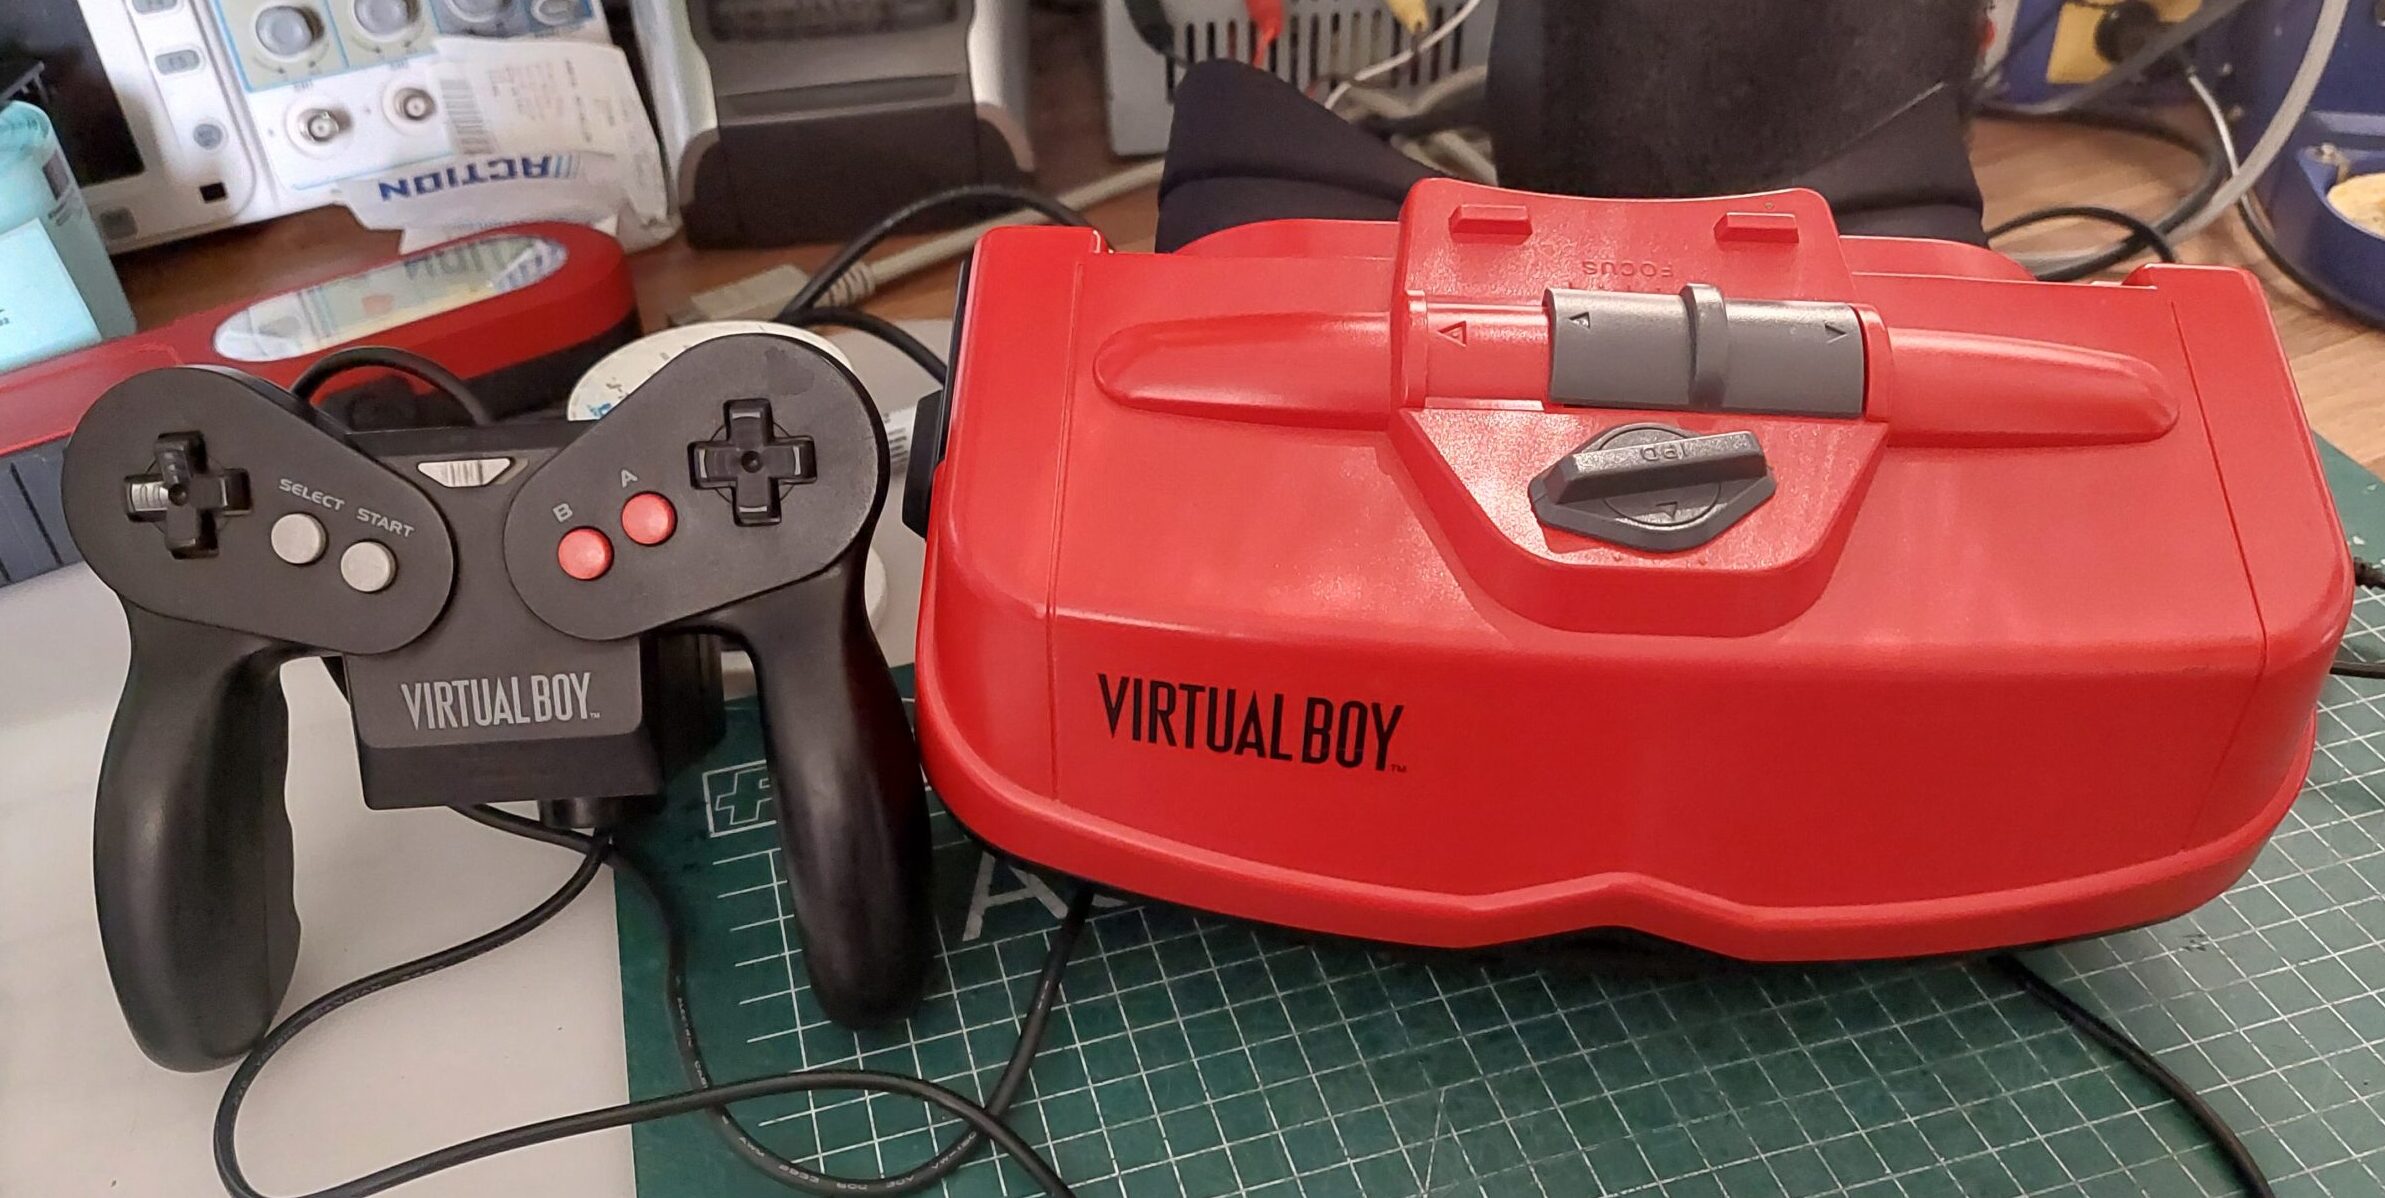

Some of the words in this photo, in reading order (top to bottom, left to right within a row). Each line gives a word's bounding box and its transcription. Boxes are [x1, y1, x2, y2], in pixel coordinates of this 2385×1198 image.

[378, 154, 552, 201] ACTION
[1581, 261, 1674, 278] FOCUS
[1639, 441, 1688, 462] IPD
[278, 477, 346, 512] SELECT
[620, 468, 639, 489] A
[355, 506, 416, 539] START
[551, 502, 574, 524] B
[400, 675, 531, 731] VIRTUAL
[529, 671, 592, 723] BOY
[1096, 671, 1292, 761] VIRTUAL
[1300, 696, 1404, 772] BOY
